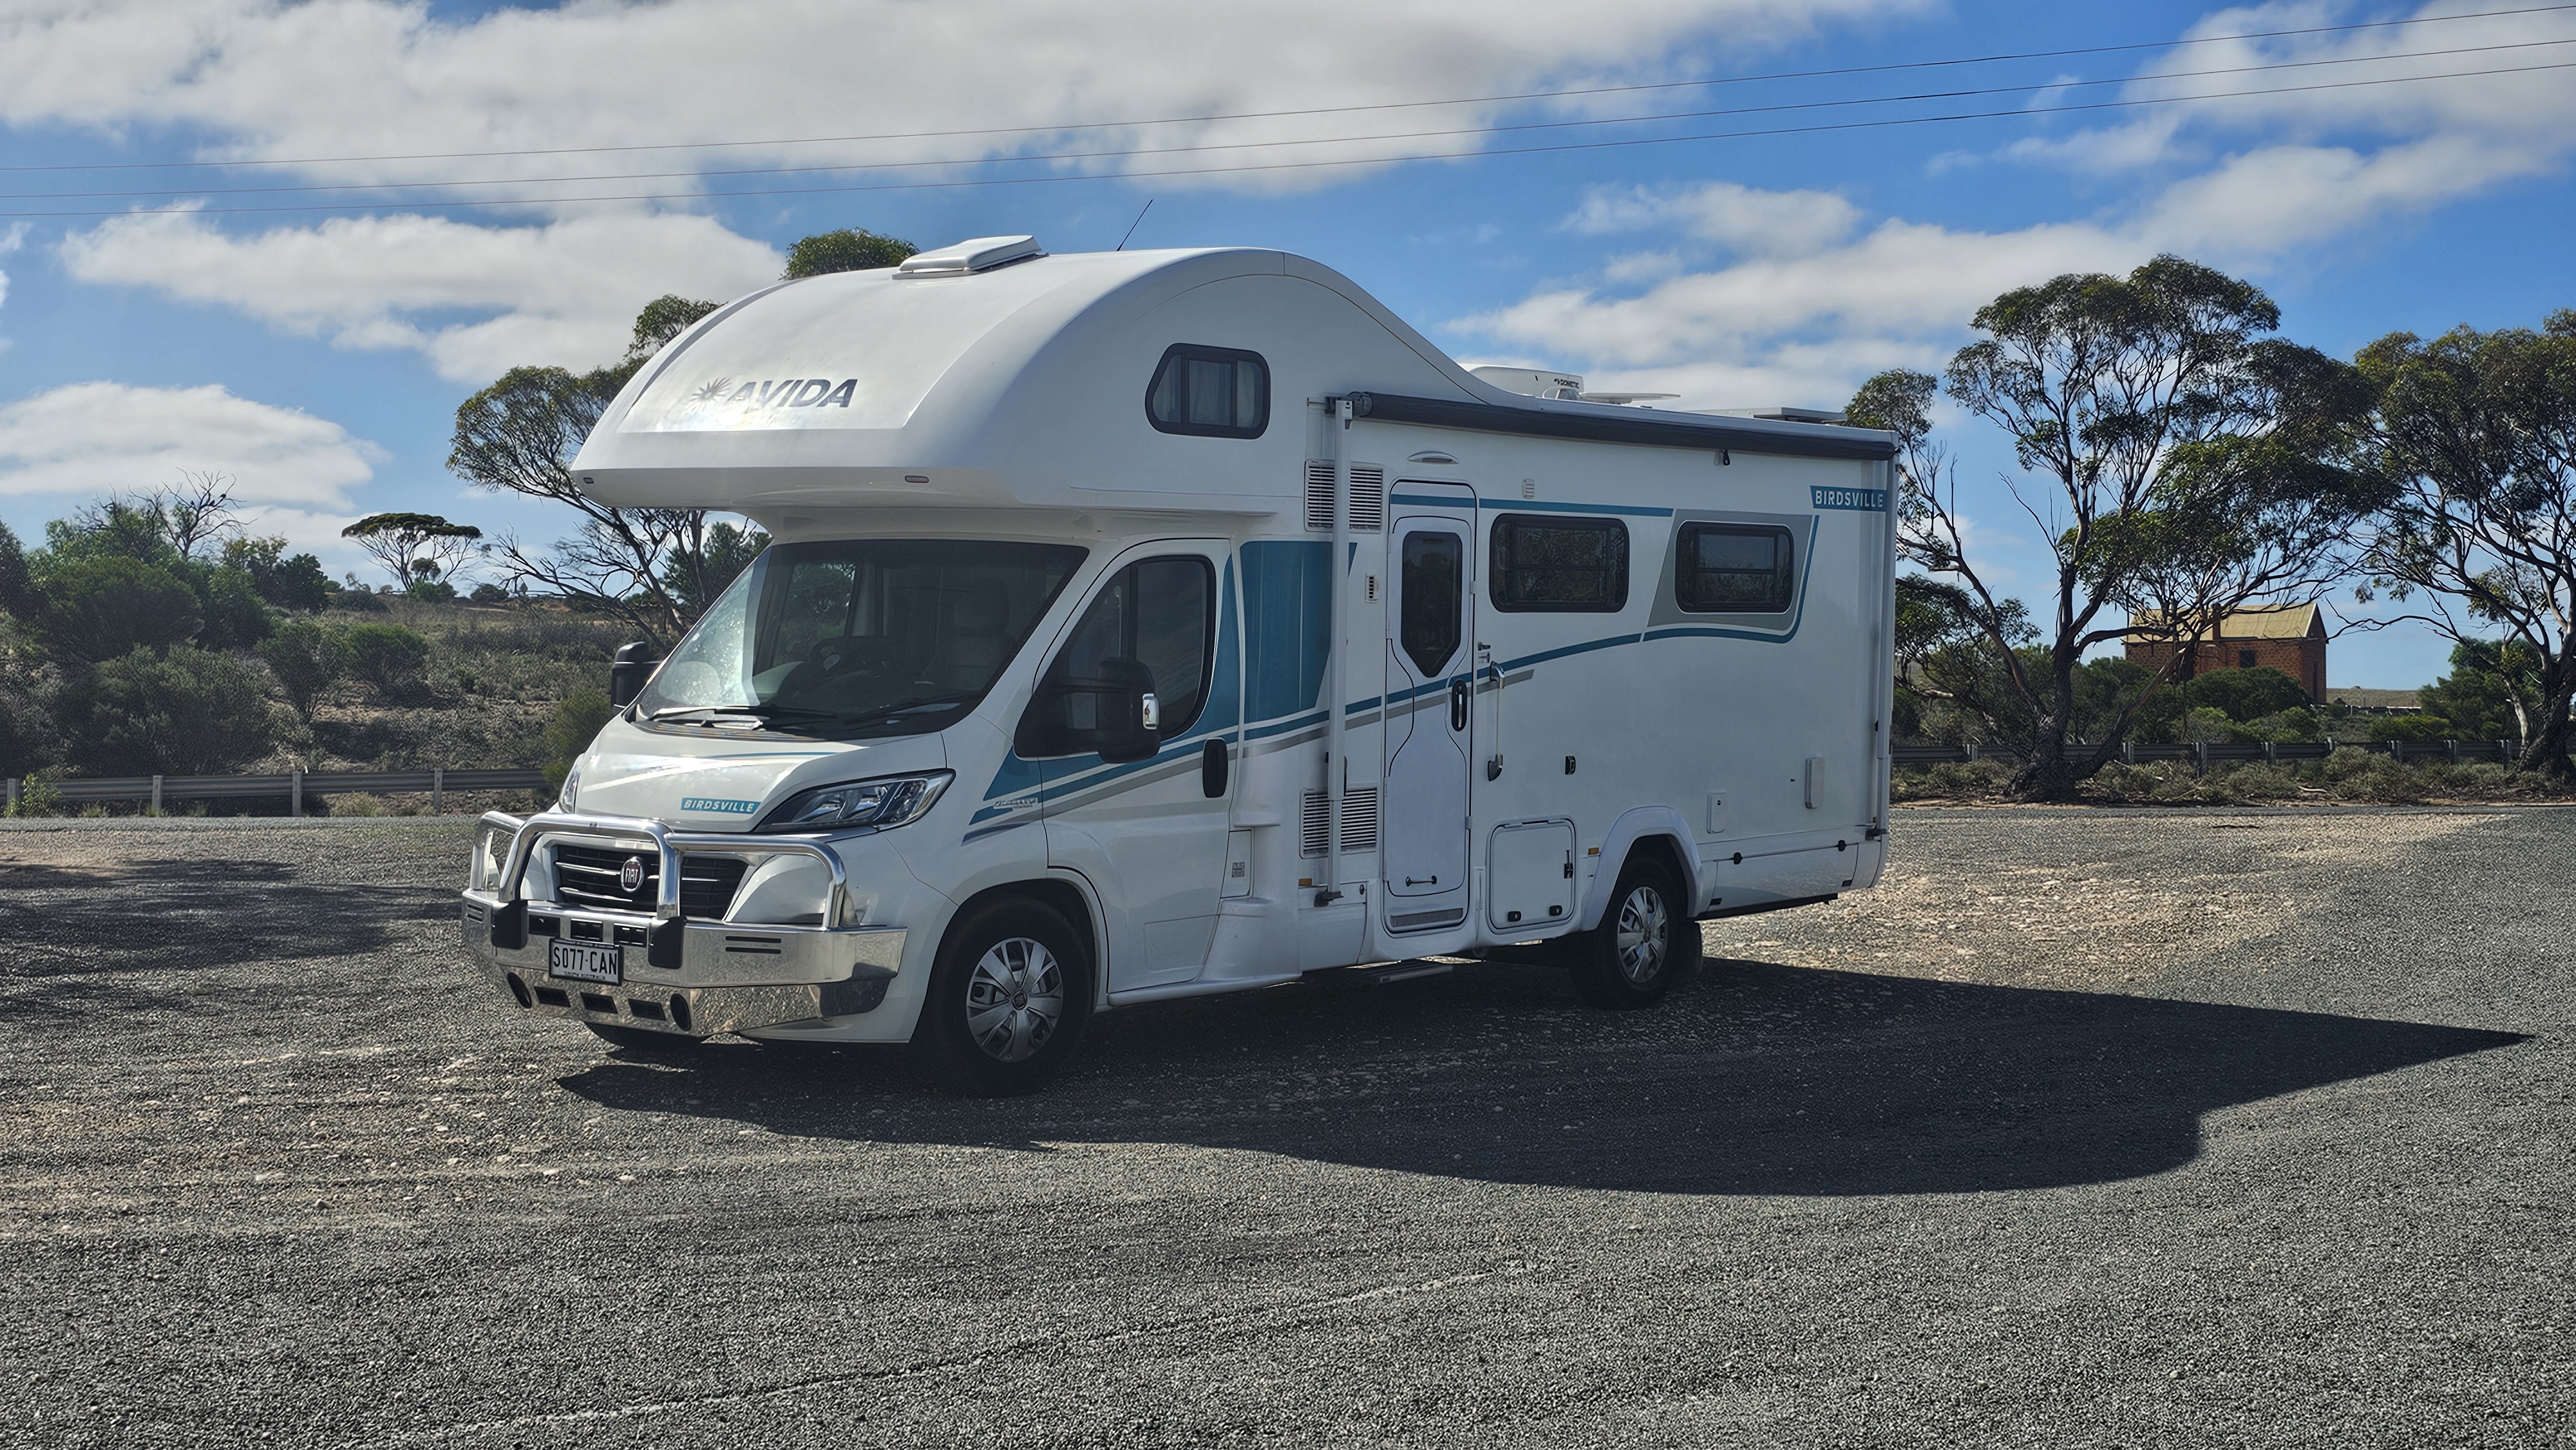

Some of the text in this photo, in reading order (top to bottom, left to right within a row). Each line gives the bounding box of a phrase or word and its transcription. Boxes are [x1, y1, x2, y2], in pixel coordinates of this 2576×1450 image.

[727, 379, 858, 410] AVIDA
[1815, 490, 1883, 507] BIRDSVILLE
[683, 800, 754, 812] BIRDSVILLE
[625, 868, 639, 883] FIAT
